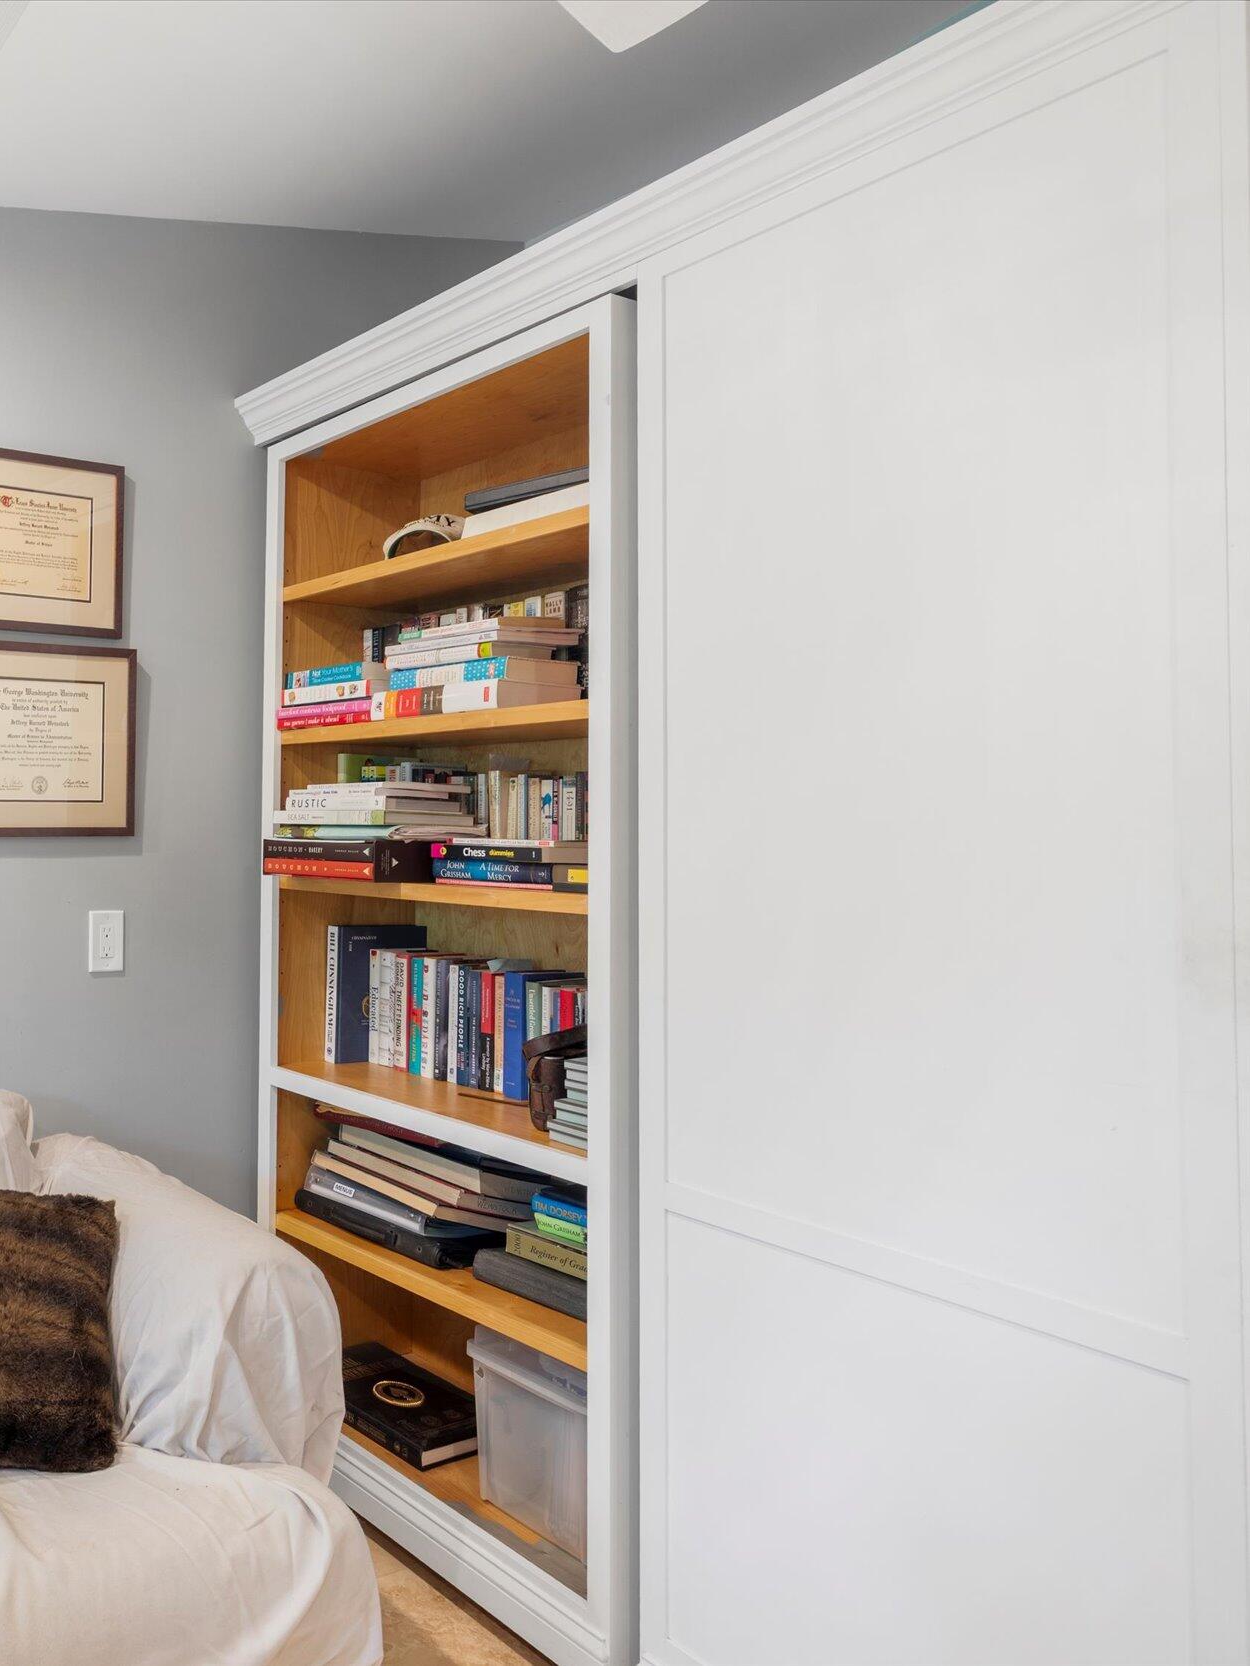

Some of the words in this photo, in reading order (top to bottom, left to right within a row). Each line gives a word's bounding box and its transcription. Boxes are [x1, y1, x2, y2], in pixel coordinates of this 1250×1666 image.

[3, 687, 23, 697] George
[25, 688, 58, 697] Washington
[60, 689, 89, 699] University
[12, 703, 29, 711] United
[32, 704, 49, 712] States
[291, 799, 326, 808] RUSTIC
[463, 848, 486, 857] Chess
[489, 849, 515, 857] dummies
[447, 860, 465, 869] JOHN
[488, 863, 503, 872] TIME
[441, 869, 472, 879] GRISHAM
[488, 872, 512, 881] MERCY
[335, 1183, 354, 1195] MENUS
[535, 1202, 547, 1211] TIM
[549, 1205, 582, 1223] DORSEY
[537, 1219, 553, 1228] JOHN
[554, 1223, 581, 1237] GRISHAM
[530, 1246, 558, 1261] Register
[559, 1258, 568, 1266] of
